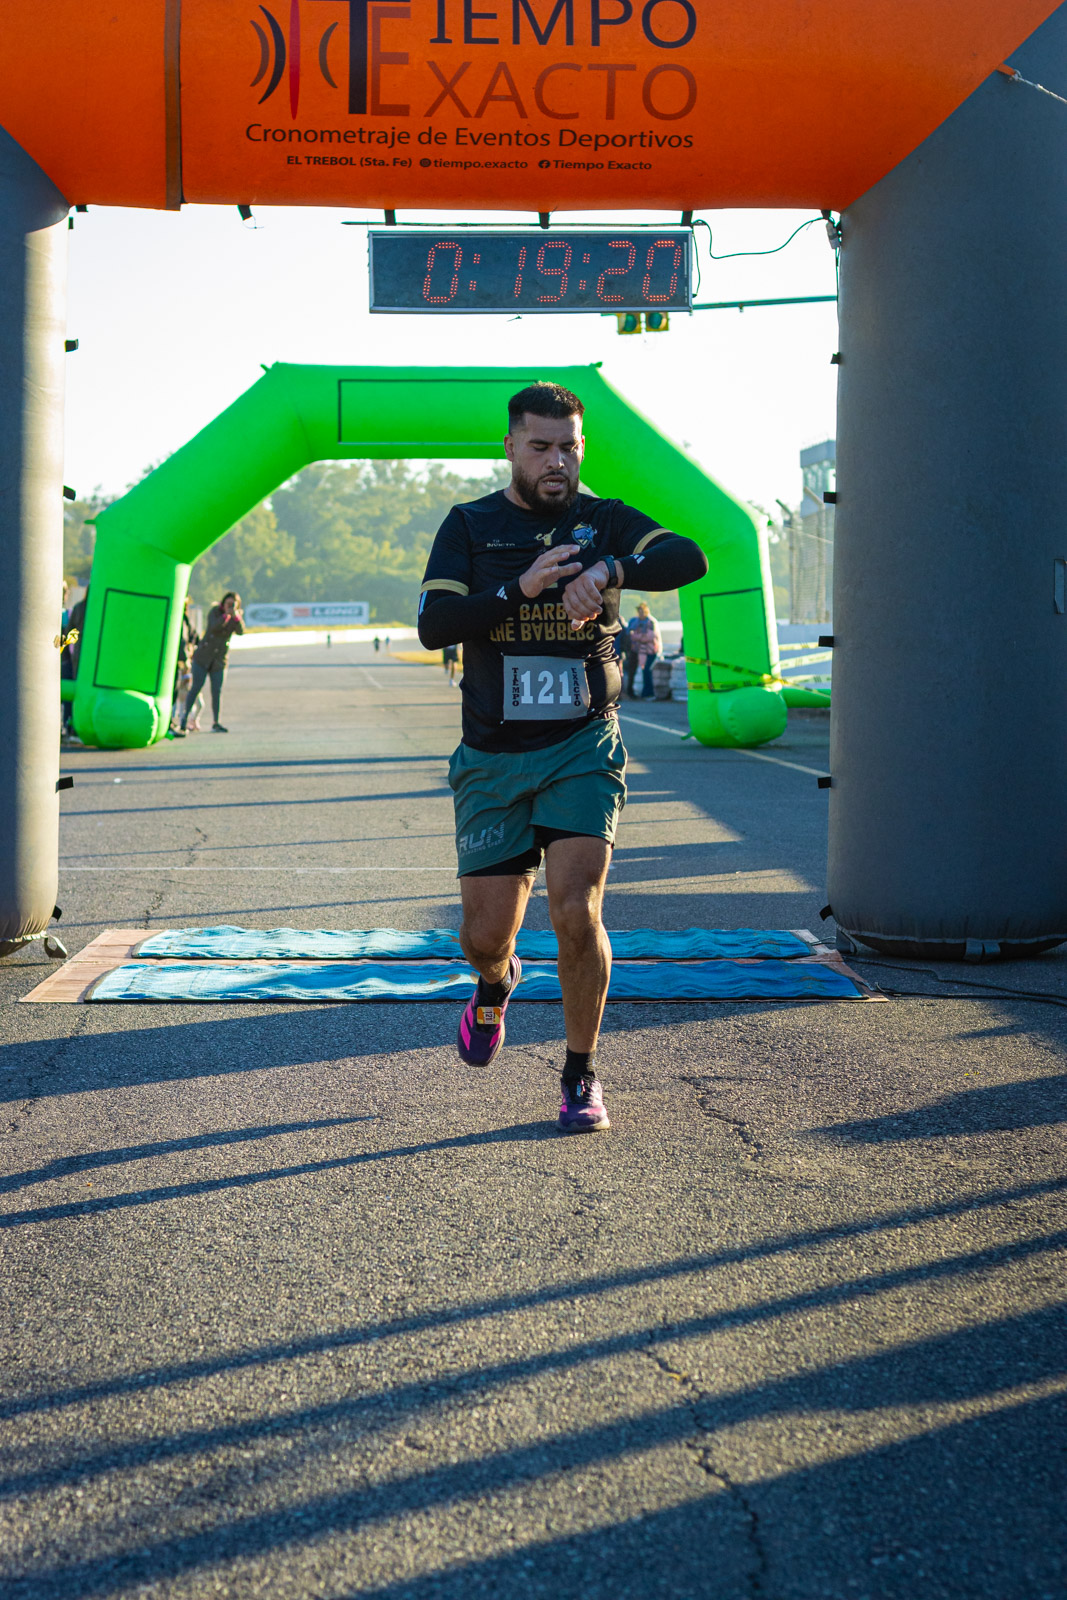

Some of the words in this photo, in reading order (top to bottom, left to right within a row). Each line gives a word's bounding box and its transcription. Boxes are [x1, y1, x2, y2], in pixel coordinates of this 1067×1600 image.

[245, 123, 411, 149] Cronometraje
[417, 126, 448, 146] de
[455, 127, 551, 147] Eventos
[558, 128, 694, 151] Deportivos
[286, 155, 302, 165] EL
[304, 155, 357, 166] TREBOL
[359, 156, 390, 167] (Sta.
[392, 157, 413, 168] Fe)
[433, 158, 529, 170] tiempo.exacto
[552, 159, 605, 171] Tiempo
[607, 160, 652, 170] Exacto
[511, 667, 520, 707] TIEMPO
[520, 670, 572, 704] 121
[571, 667, 581, 707] EXACTO
